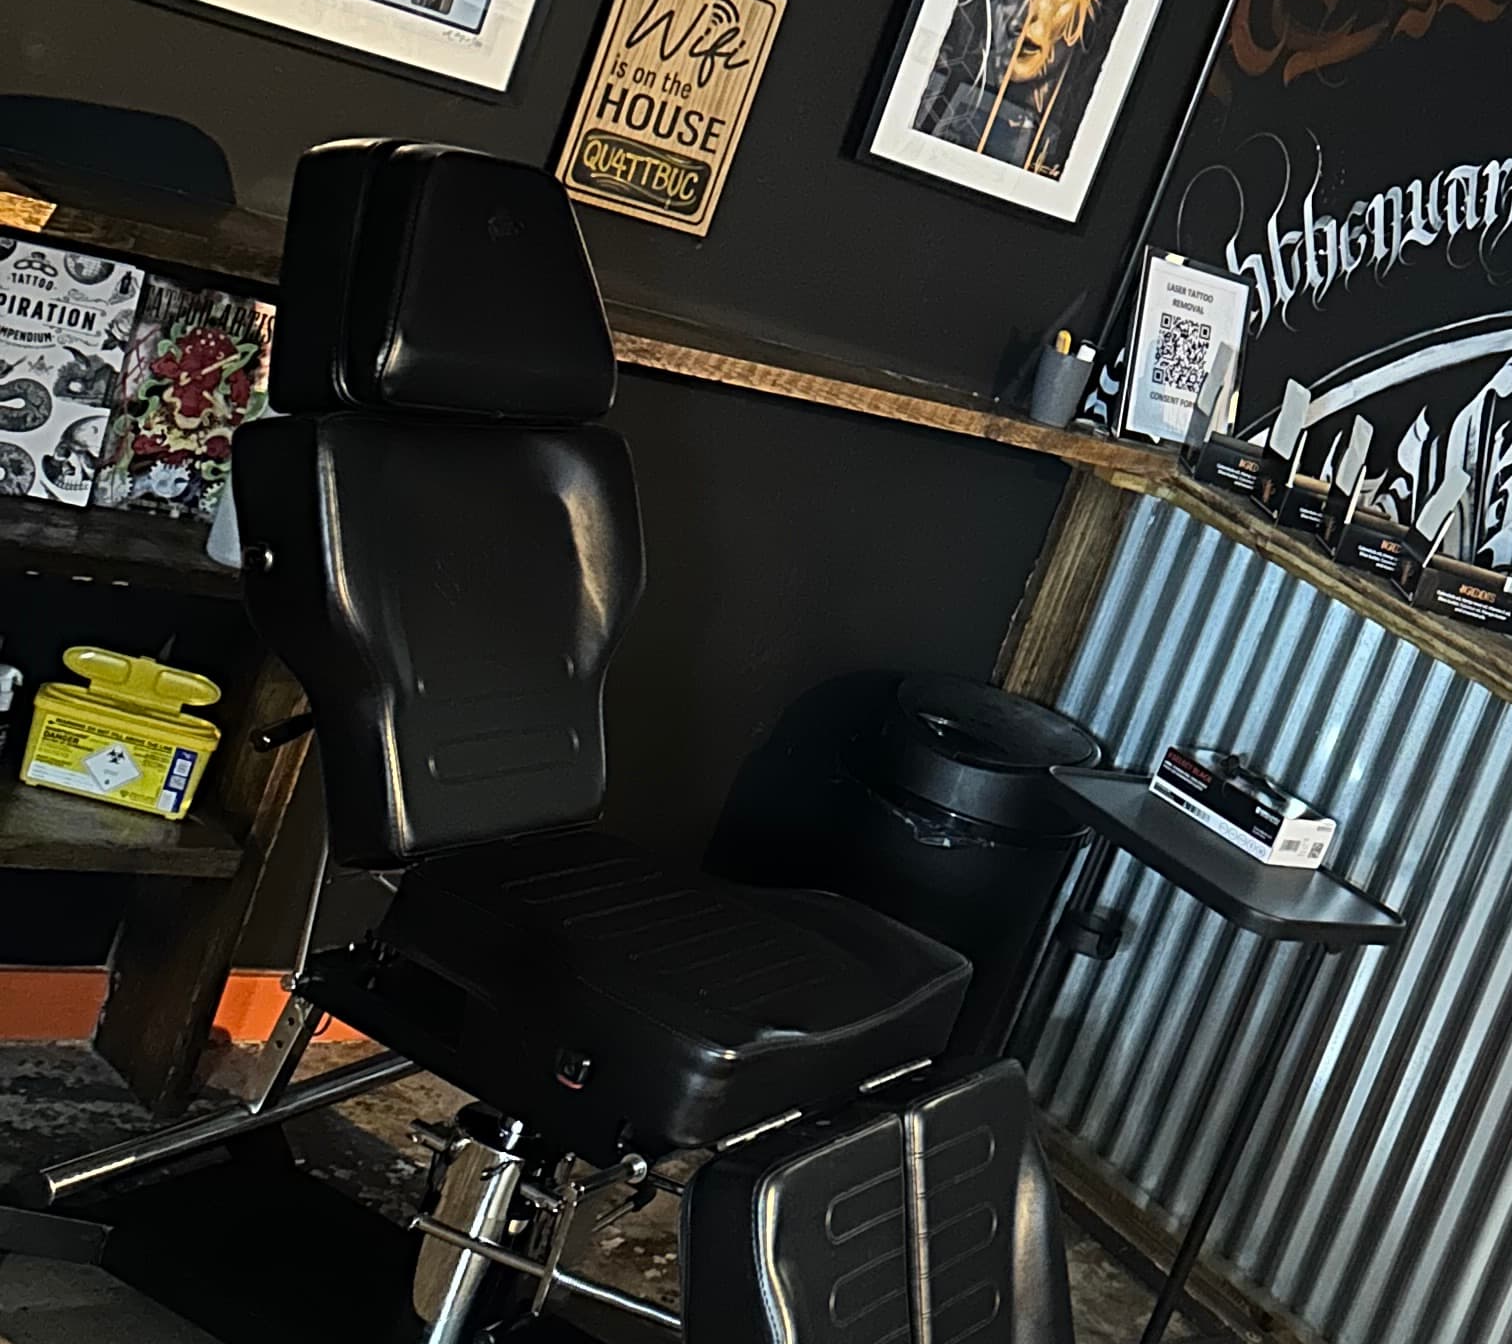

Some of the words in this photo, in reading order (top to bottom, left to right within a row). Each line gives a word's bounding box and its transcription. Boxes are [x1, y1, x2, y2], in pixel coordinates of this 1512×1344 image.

[610, 53, 627, 80] is
[632, 63, 656, 89] on
[661, 72, 692, 100] the
[596, 83, 726, 154] HOUSE
[11, 272, 54, 292] TATTOO
[1166, 282, 1187, 296] LASER
[1187, 287, 1214, 304] TATTOO
[1172, 298, 1205, 315] REMOVAL
[1150, 391, 1179, 407] CONSENT
